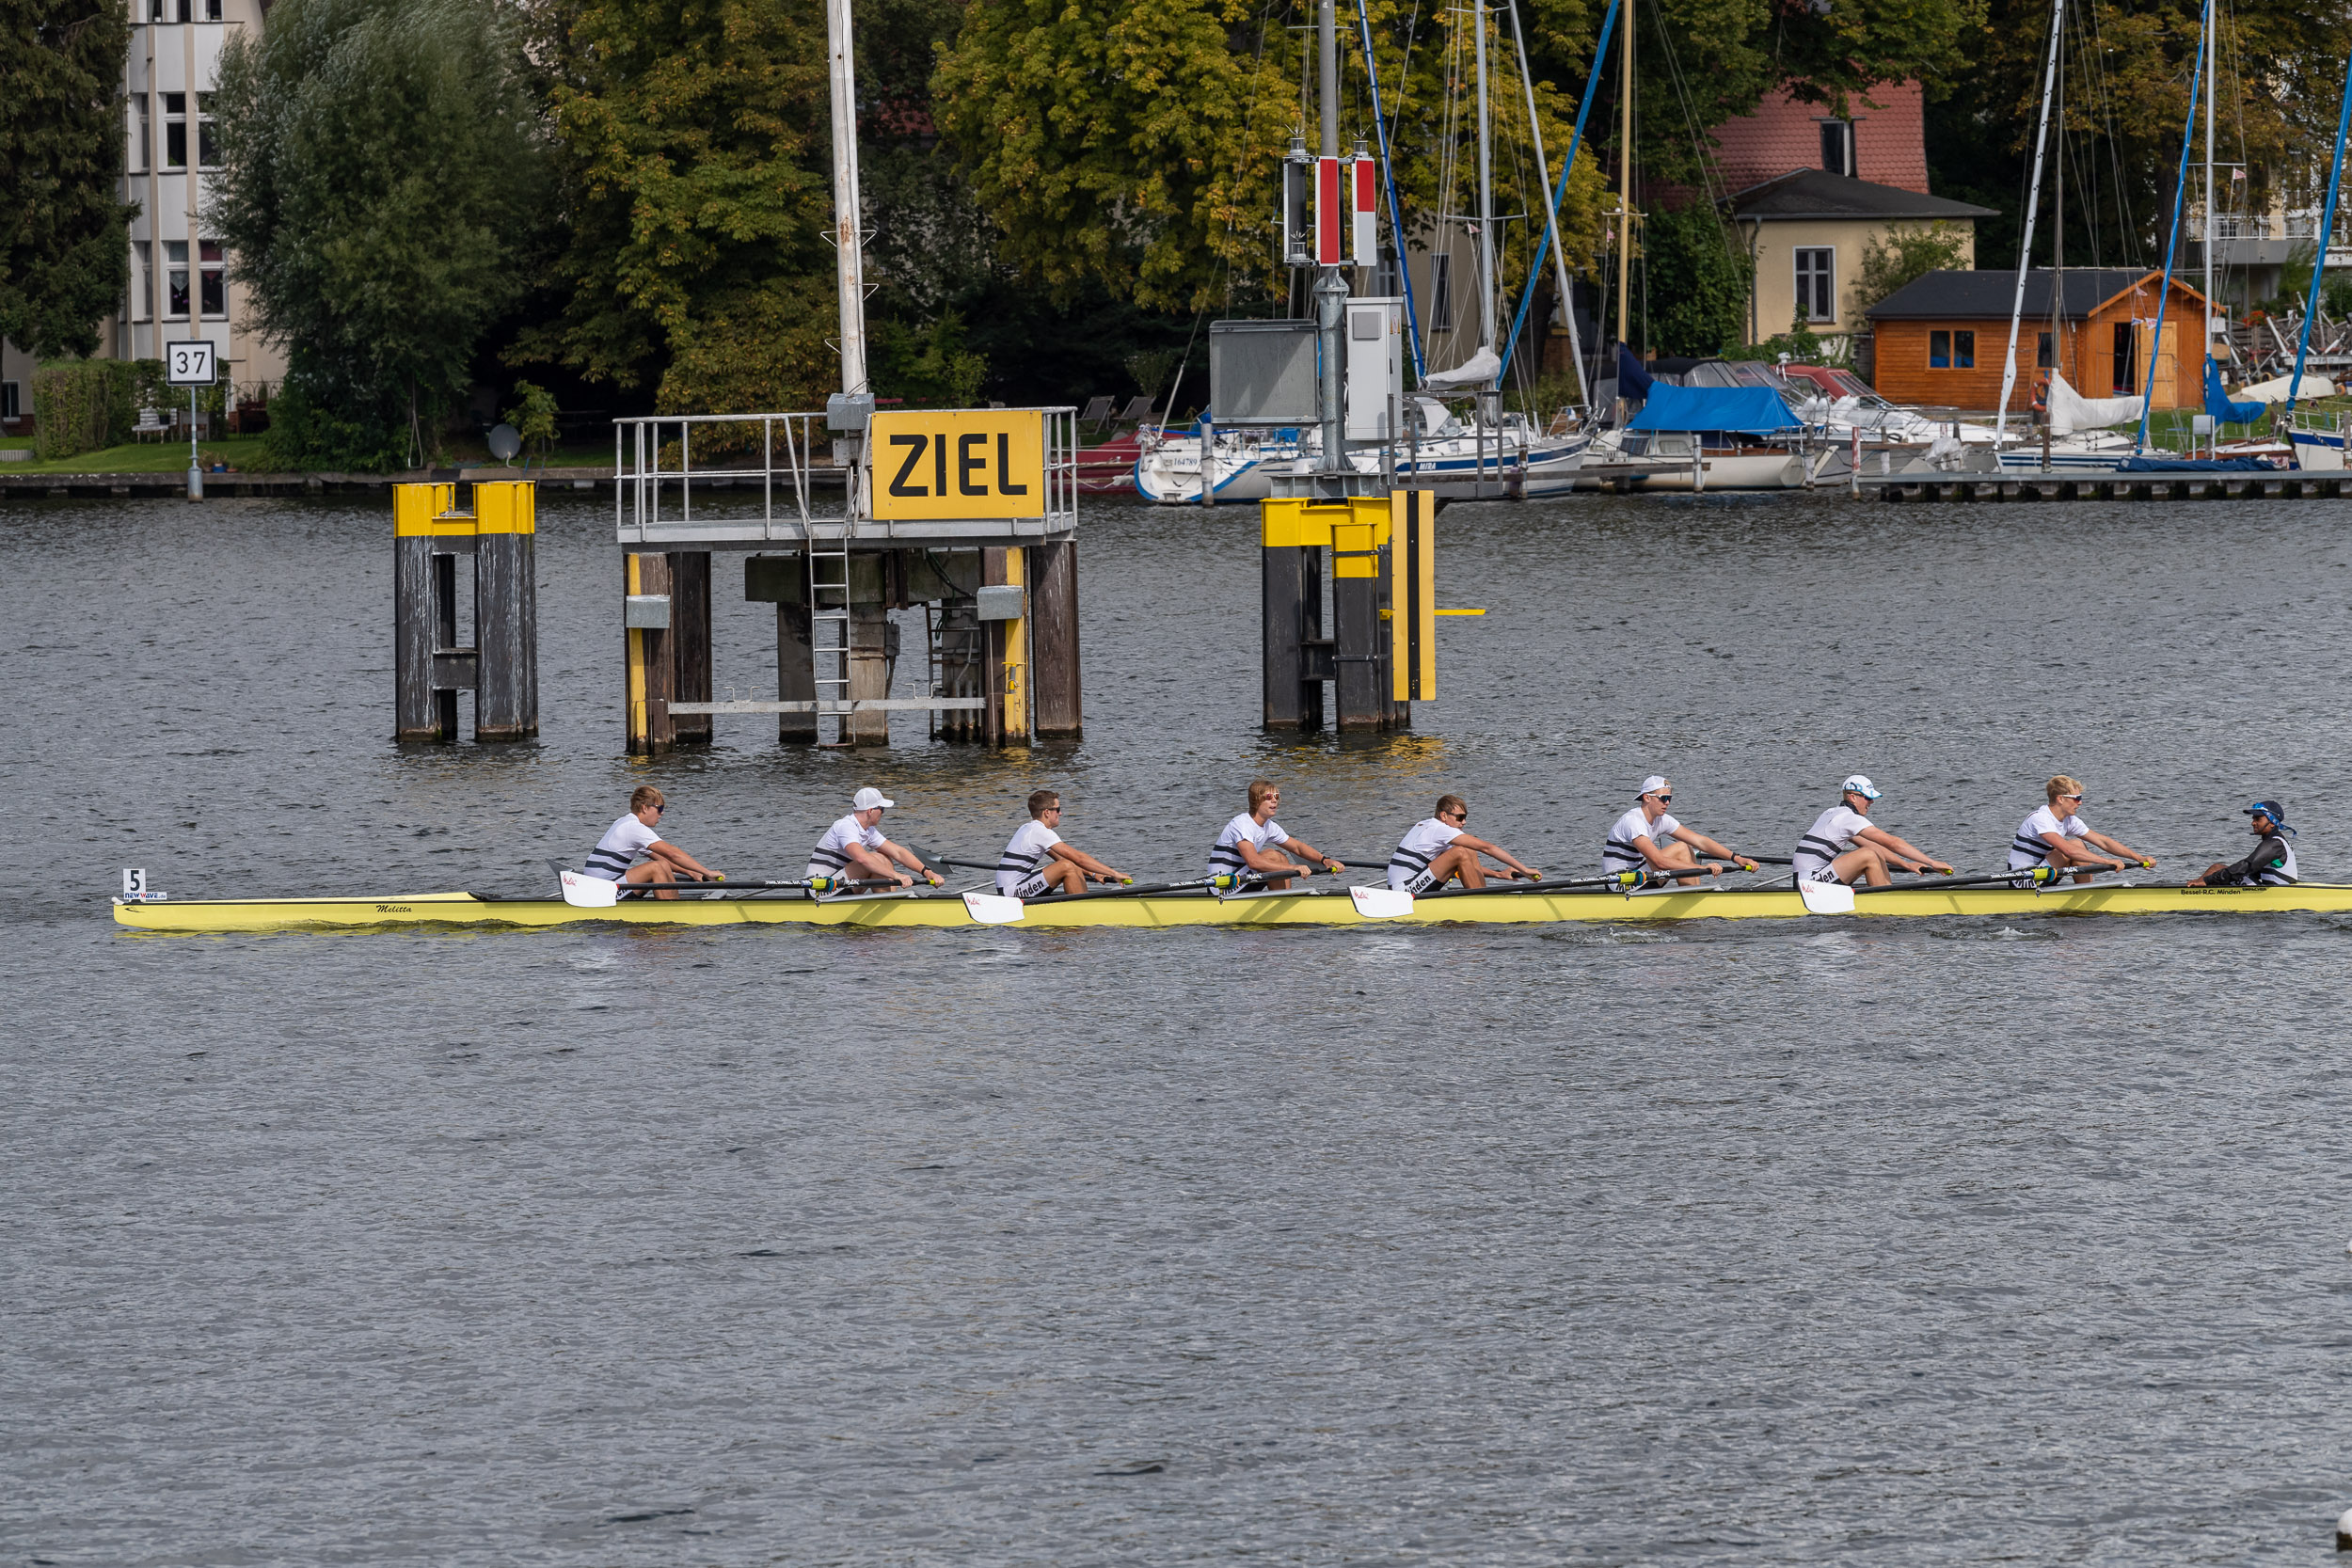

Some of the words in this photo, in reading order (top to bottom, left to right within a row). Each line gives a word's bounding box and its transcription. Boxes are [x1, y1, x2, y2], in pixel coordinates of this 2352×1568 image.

[176, 351, 206, 374] 37
[888, 433, 1028, 498] ZIEL
[1173, 458, 1198, 467] 164789
[1418, 462, 1437, 470] MIRA
[130, 869, 140, 892] 5
[375, 904, 412, 912] Melitta
